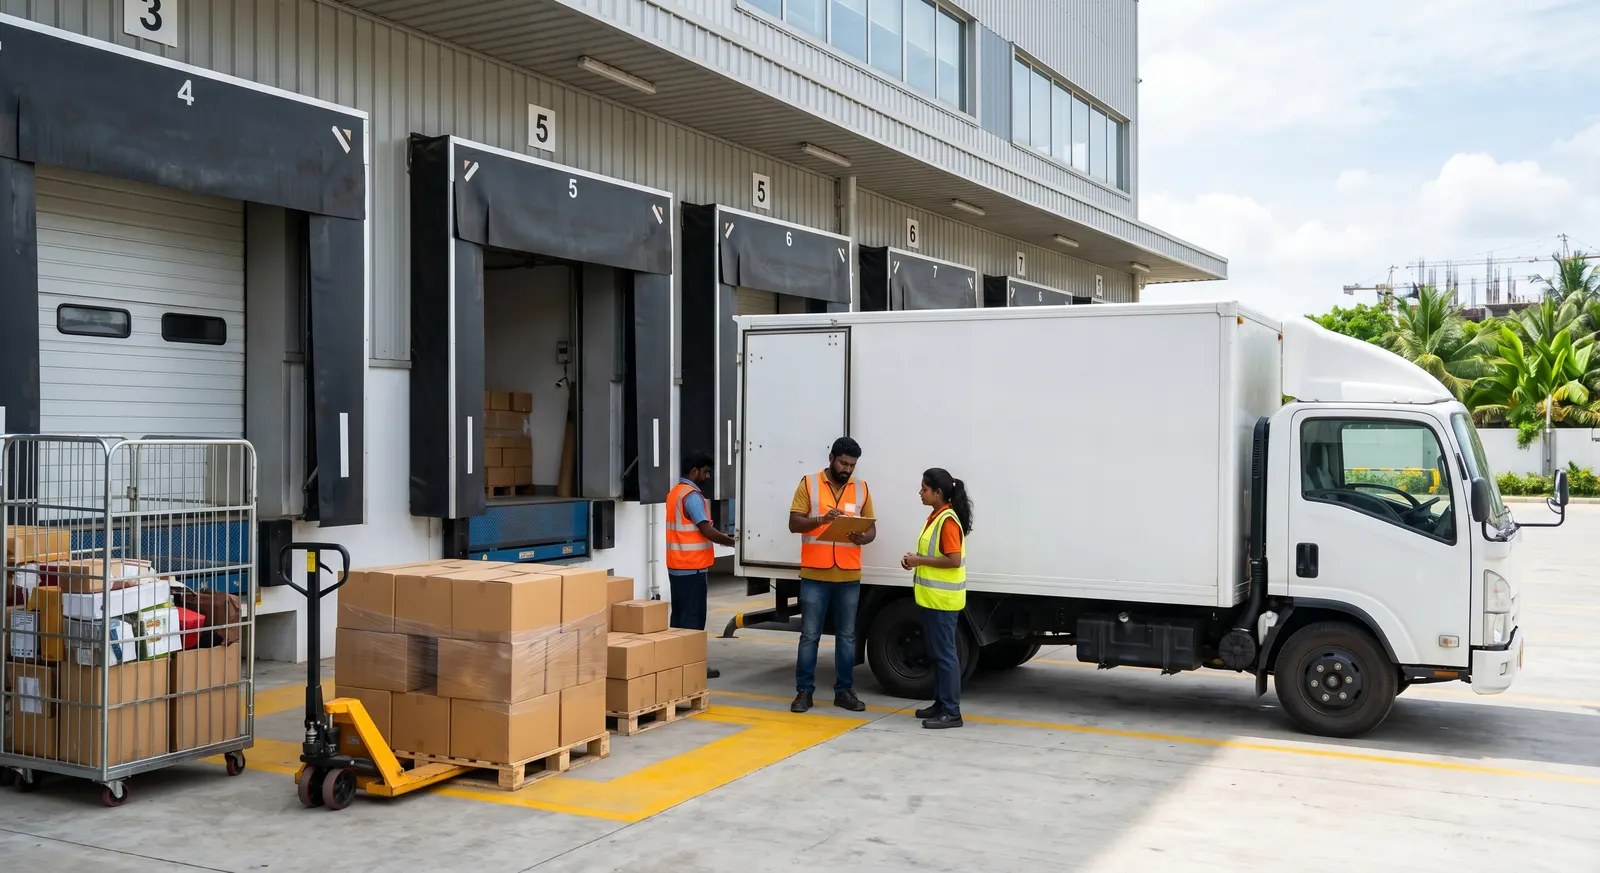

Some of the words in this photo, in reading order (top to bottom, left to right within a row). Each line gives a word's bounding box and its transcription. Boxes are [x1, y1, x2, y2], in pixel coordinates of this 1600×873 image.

[139, 0, 163, 32] 3
[177, 79, 195, 106] 4
[535, 113, 549, 143] 5
[568, 178, 578, 199] 5
[757, 179, 766, 203] 5
[786, 231, 793, 247] 6
[910, 224, 916, 243] 6
[933, 265, 938, 278] 7
[1018, 256, 1023, 272] 7
